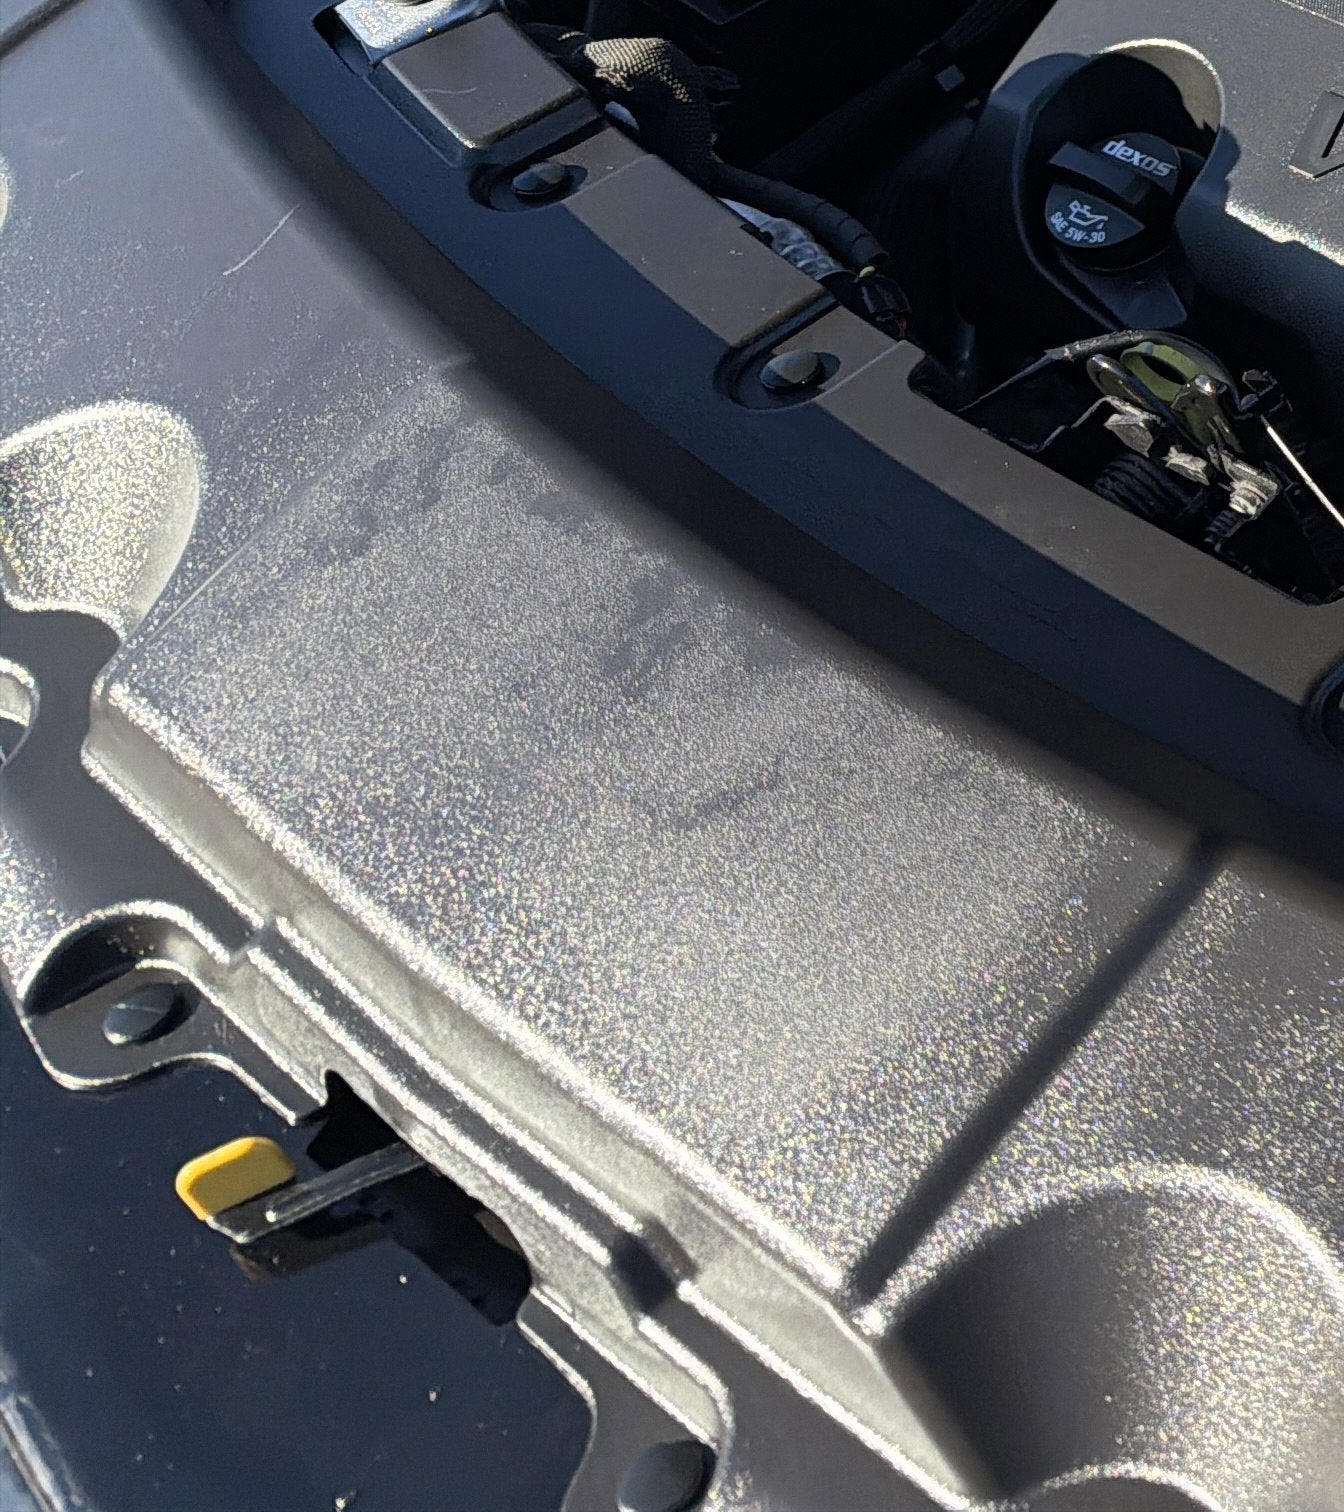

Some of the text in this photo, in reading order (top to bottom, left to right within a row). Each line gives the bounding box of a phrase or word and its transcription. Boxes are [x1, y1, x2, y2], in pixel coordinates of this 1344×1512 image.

[1102, 140, 1178, 177] dexos
[1051, 212, 1106, 244] SAE 5W-30
